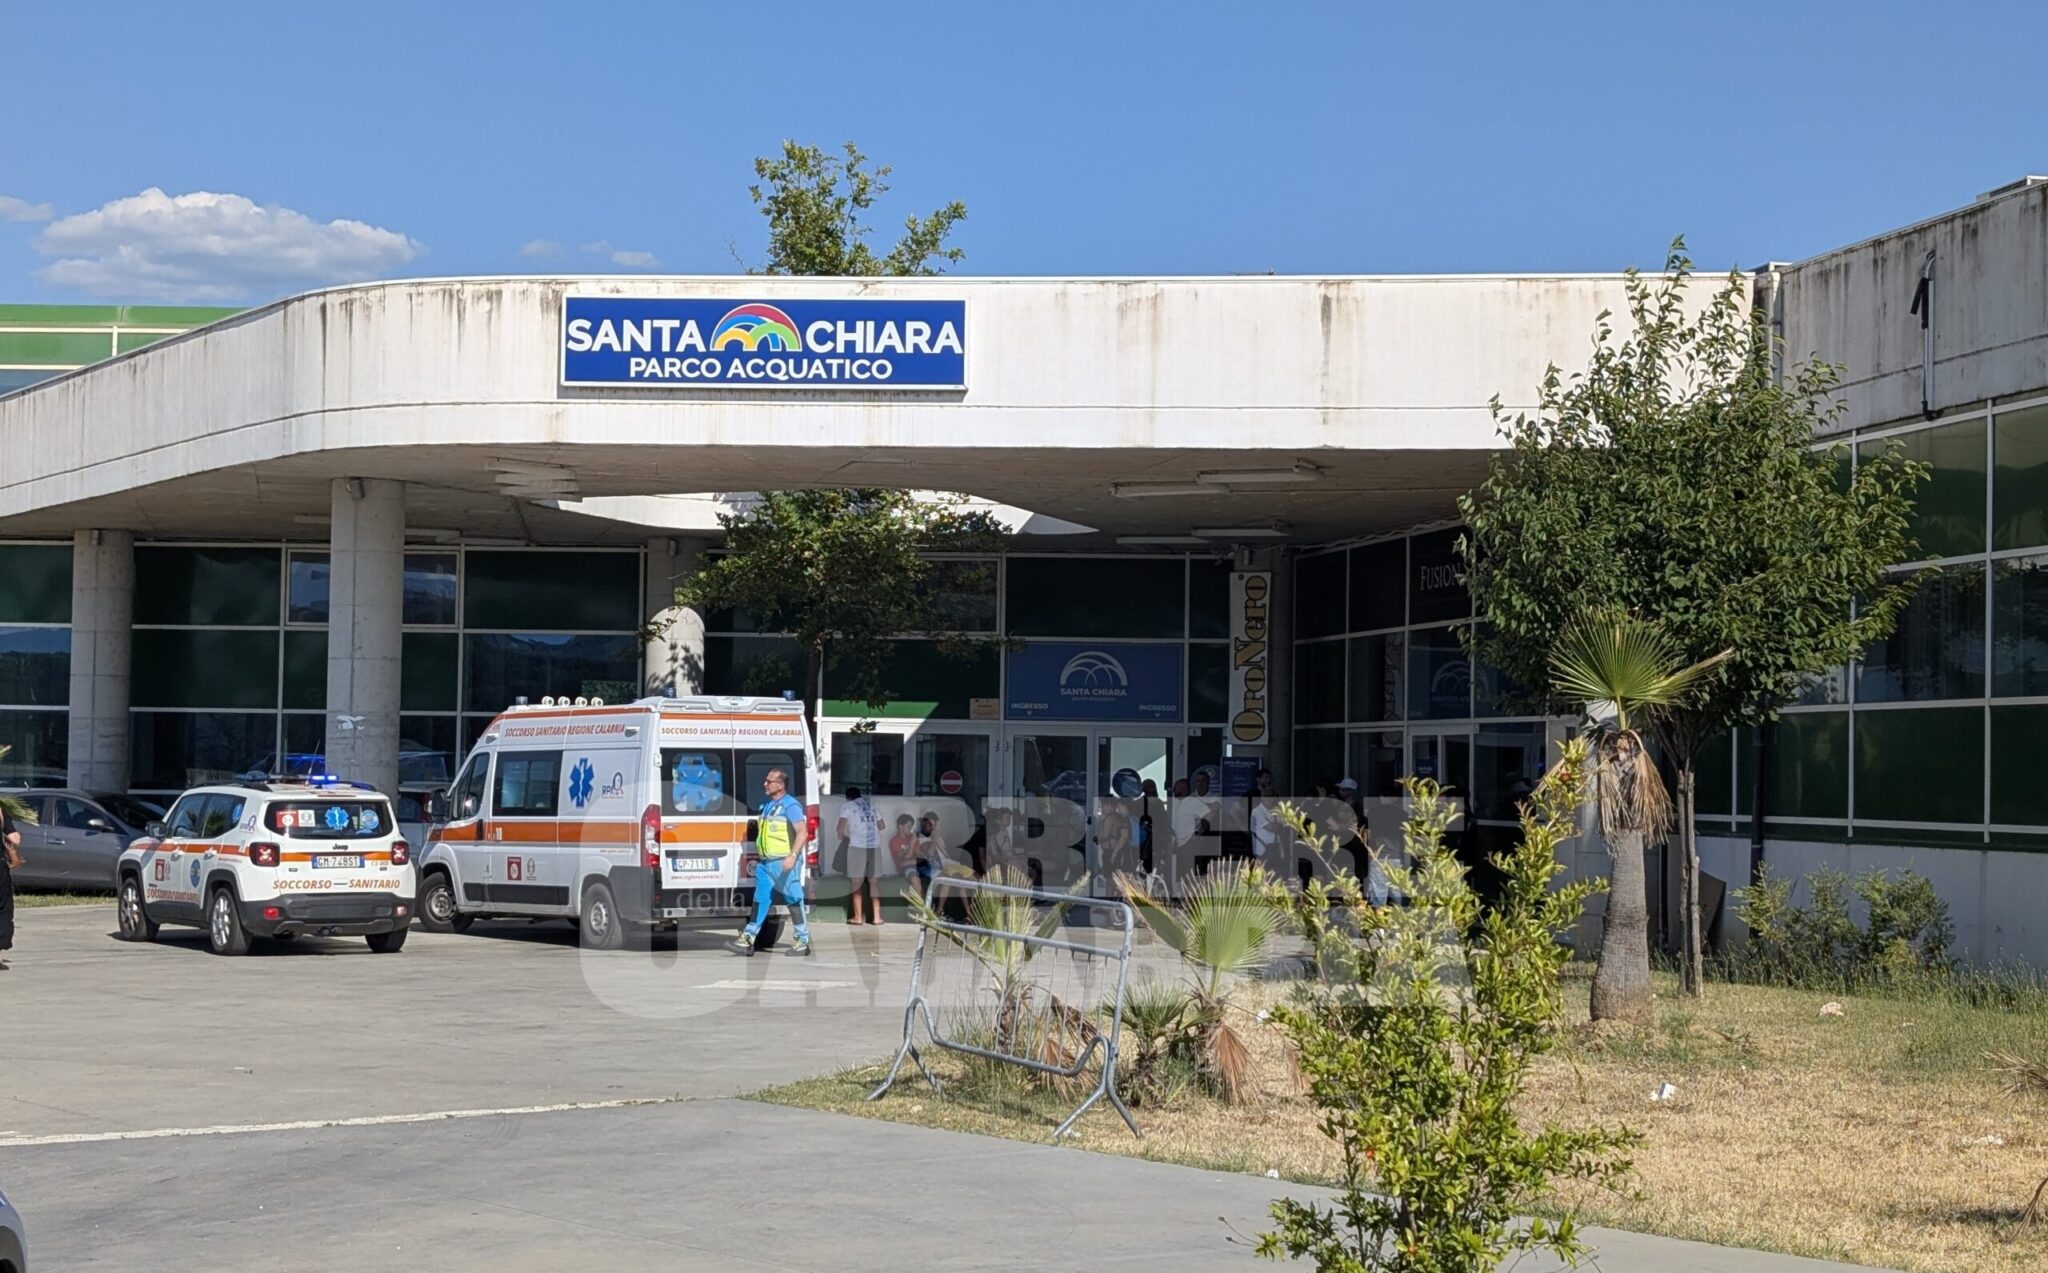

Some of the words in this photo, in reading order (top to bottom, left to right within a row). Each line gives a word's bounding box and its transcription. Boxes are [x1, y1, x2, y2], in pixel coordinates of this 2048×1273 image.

[567, 319, 707, 353] SANTA
[805, 320, 964, 355] CHIARA
[629, 357, 718, 379] PARCO
[726, 357, 893, 381] ACQUATICO
[1060, 688, 1090, 697] SANTA
[1092, 688, 1128, 697] CHIARA
[1139, 704, 1177, 712] INGRESSO
[505, 727, 534, 738] SOCCORSO
[535, 726, 567, 737] SANITARIO
[568, 725, 595, 736] REGIONE
[595, 723, 626, 735] CALABRIA
[662, 727, 698, 736] SOCCORSO
[700, 727, 737, 736] SANITARIO
[738, 728, 768, 736] REGIONE
[769, 728, 802, 736] CALABRIA
[332, 843, 349, 851] Jeep
[273, 880, 332, 889] SOCCORSO
[349, 879, 400, 889] SANITARIO
